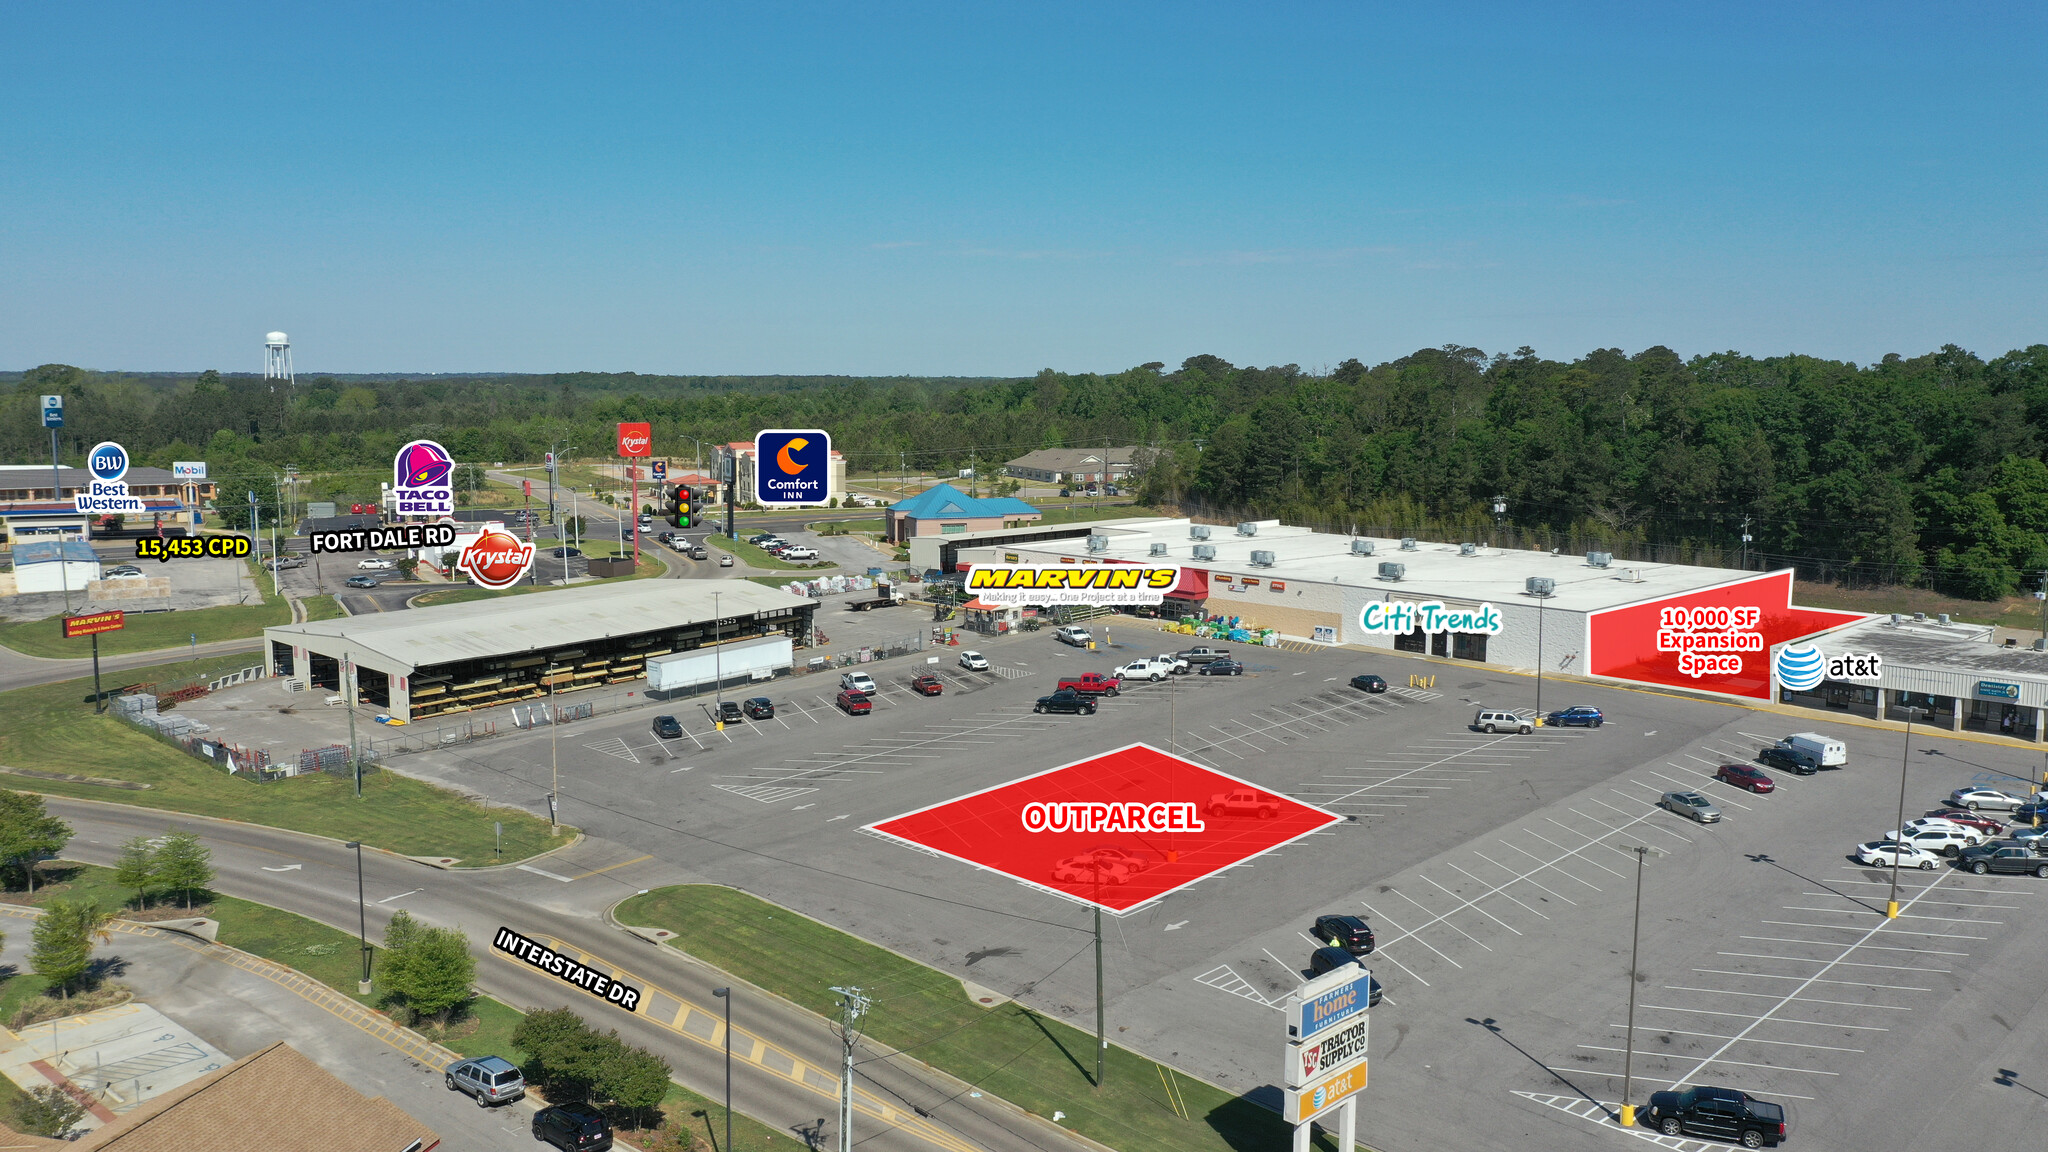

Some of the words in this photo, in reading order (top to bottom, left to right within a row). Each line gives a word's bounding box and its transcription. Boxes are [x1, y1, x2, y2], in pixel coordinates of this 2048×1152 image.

[622, 437, 649, 447] Krystal
[175, 466, 204, 475] Mobil
[70, 614, 120, 627] MARVIN'S
[1320, 983, 1353, 1004] FARMERS
[1313, 990, 1357, 1022] home
[1315, 1006, 1354, 1030] FURNITURE
[1321, 1021, 1366, 1055] TRACTOR
[1303, 1050, 1318, 1069] TSC
[1320, 1044, 1352, 1071] SUPPLY
[1327, 1072, 1353, 1100] at&t
